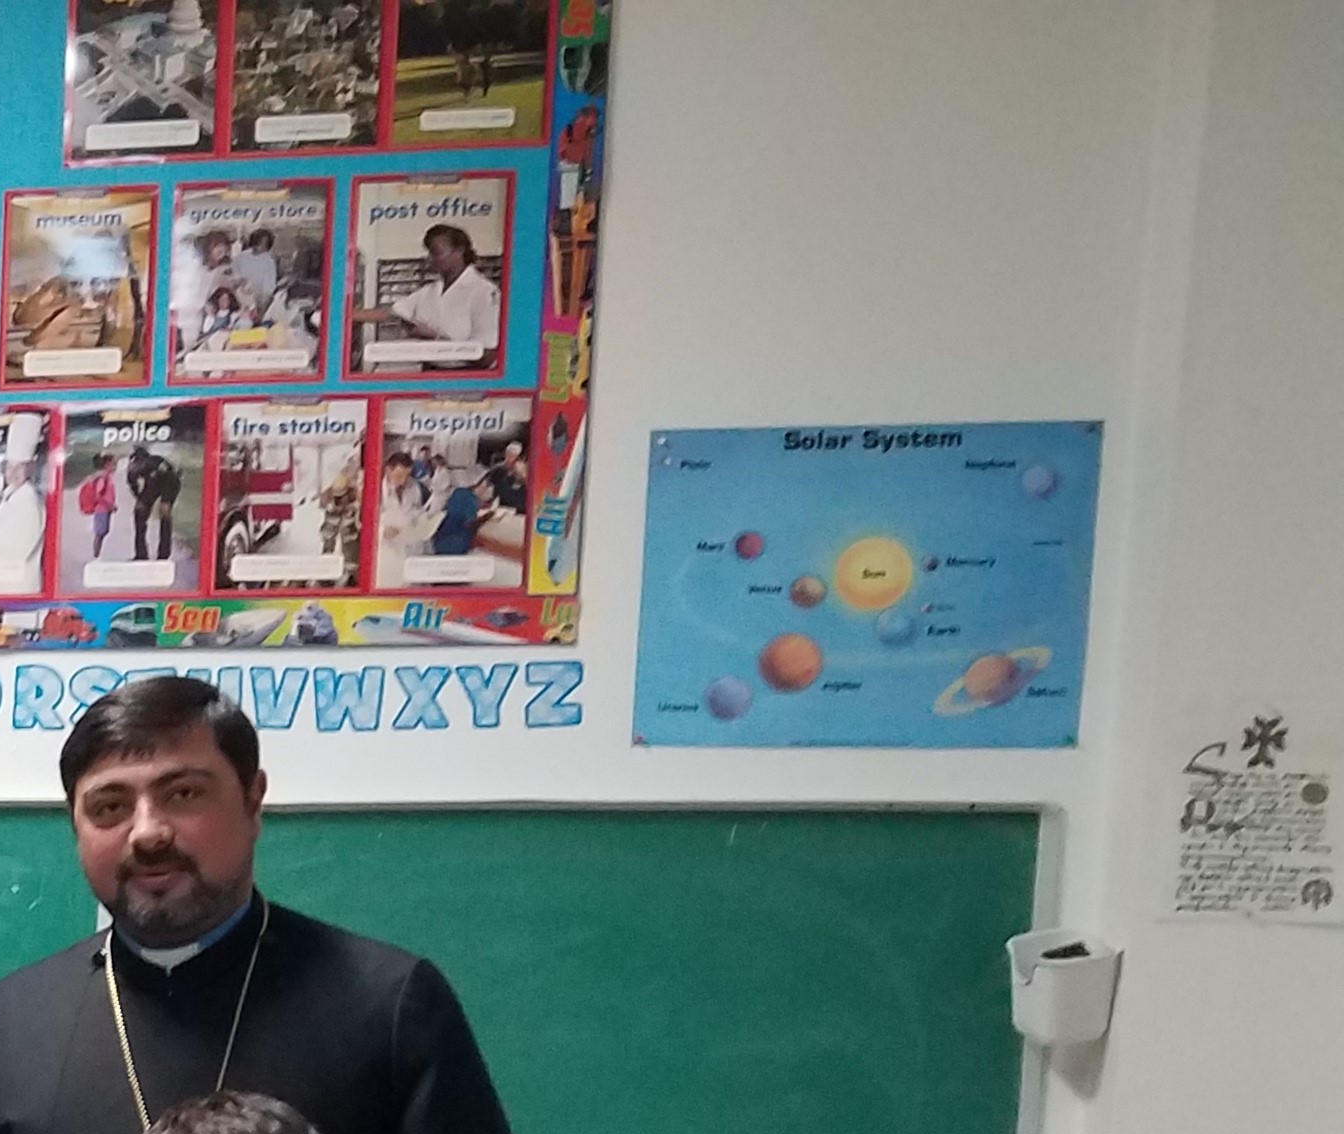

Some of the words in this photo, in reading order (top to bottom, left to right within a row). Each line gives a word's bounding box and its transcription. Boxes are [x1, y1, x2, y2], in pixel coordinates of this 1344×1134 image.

[36, 212, 122, 230] museum
[190, 207, 261, 224] grocery
[269, 203, 317, 221] store
[370, 200, 417, 225] post
[427, 197, 493, 219] office
[231, 416, 271, 436] fire
[278, 415, 357, 434] station
[409, 410, 506, 434] hospital
[102, 422, 171, 448] police
[783, 429, 853, 450] Solar
[862, 429, 963, 453] System
[163, 601, 221, 634] Sea
[400, 601, 453, 633] Air
